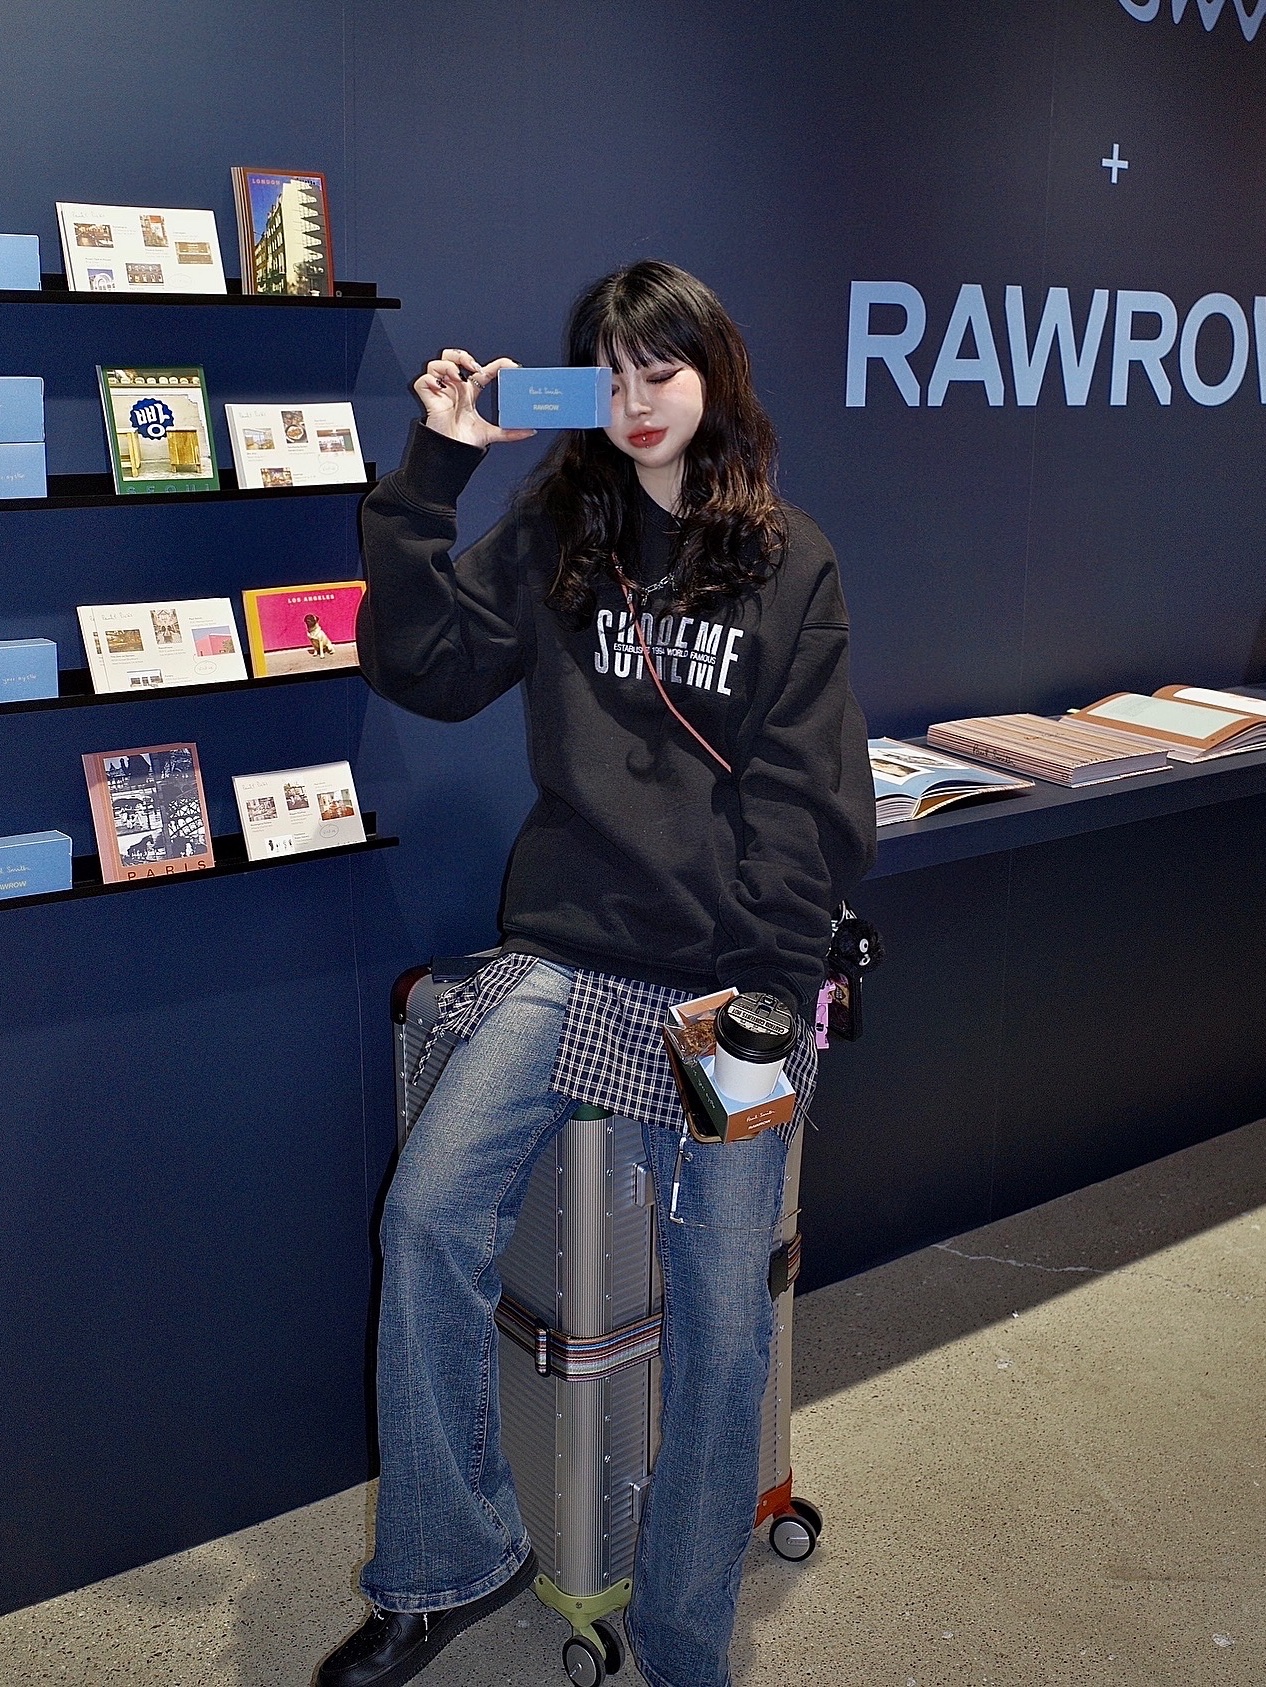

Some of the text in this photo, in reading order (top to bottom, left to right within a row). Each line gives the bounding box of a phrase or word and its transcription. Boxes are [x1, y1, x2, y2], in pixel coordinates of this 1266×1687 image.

[252, 178, 280, 186] LONDON
[845, 280, 1266, 407] RAWRO
[303, 594, 335, 603] ANGELES
[666, 648, 689, 658] WORLD
[690, 651, 717, 665] FAMOUS
[127, 860, 207, 881] PARIS
[731, 1008, 743, 1016] HOT
[742, 1011, 766, 1026] CONTENTS
[765, 1021, 785, 1033] CAUTION
